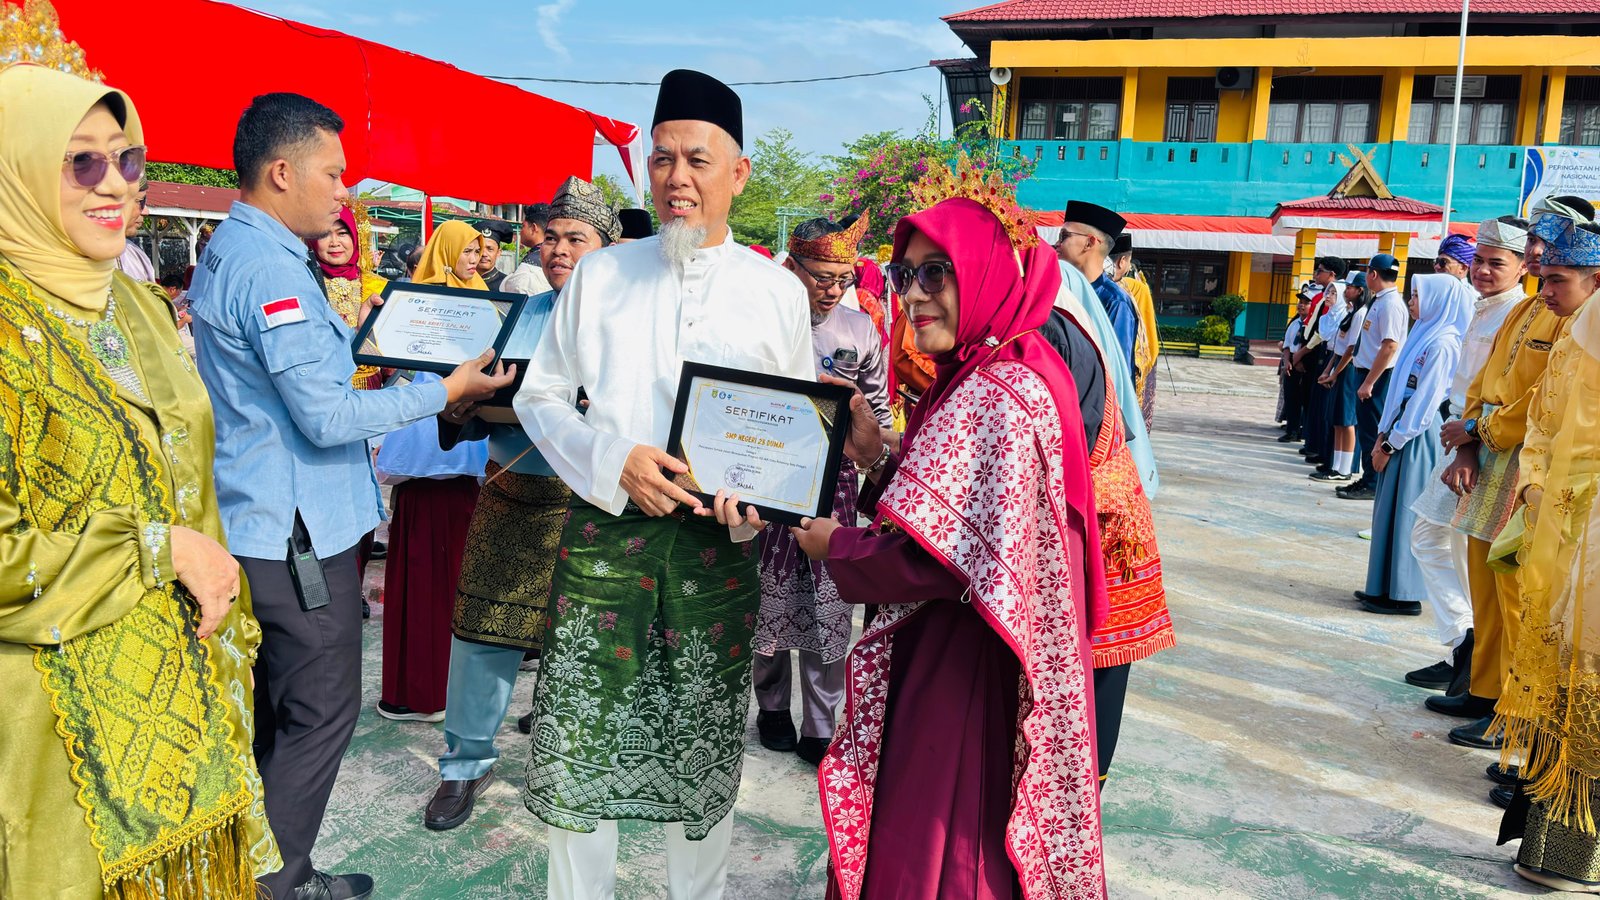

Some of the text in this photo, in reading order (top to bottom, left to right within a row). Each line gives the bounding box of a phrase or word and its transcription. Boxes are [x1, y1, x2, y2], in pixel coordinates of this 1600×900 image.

[1548, 164, 1594, 172] PERINGATAN
[418, 307, 476, 317] SERTIFIKAT
[724, 405, 795, 425] SERTIFIKAT
[724, 431, 738, 440] SMP
[738, 433, 757, 444] NEGERI
[766, 439, 785, 449] DUMAI
